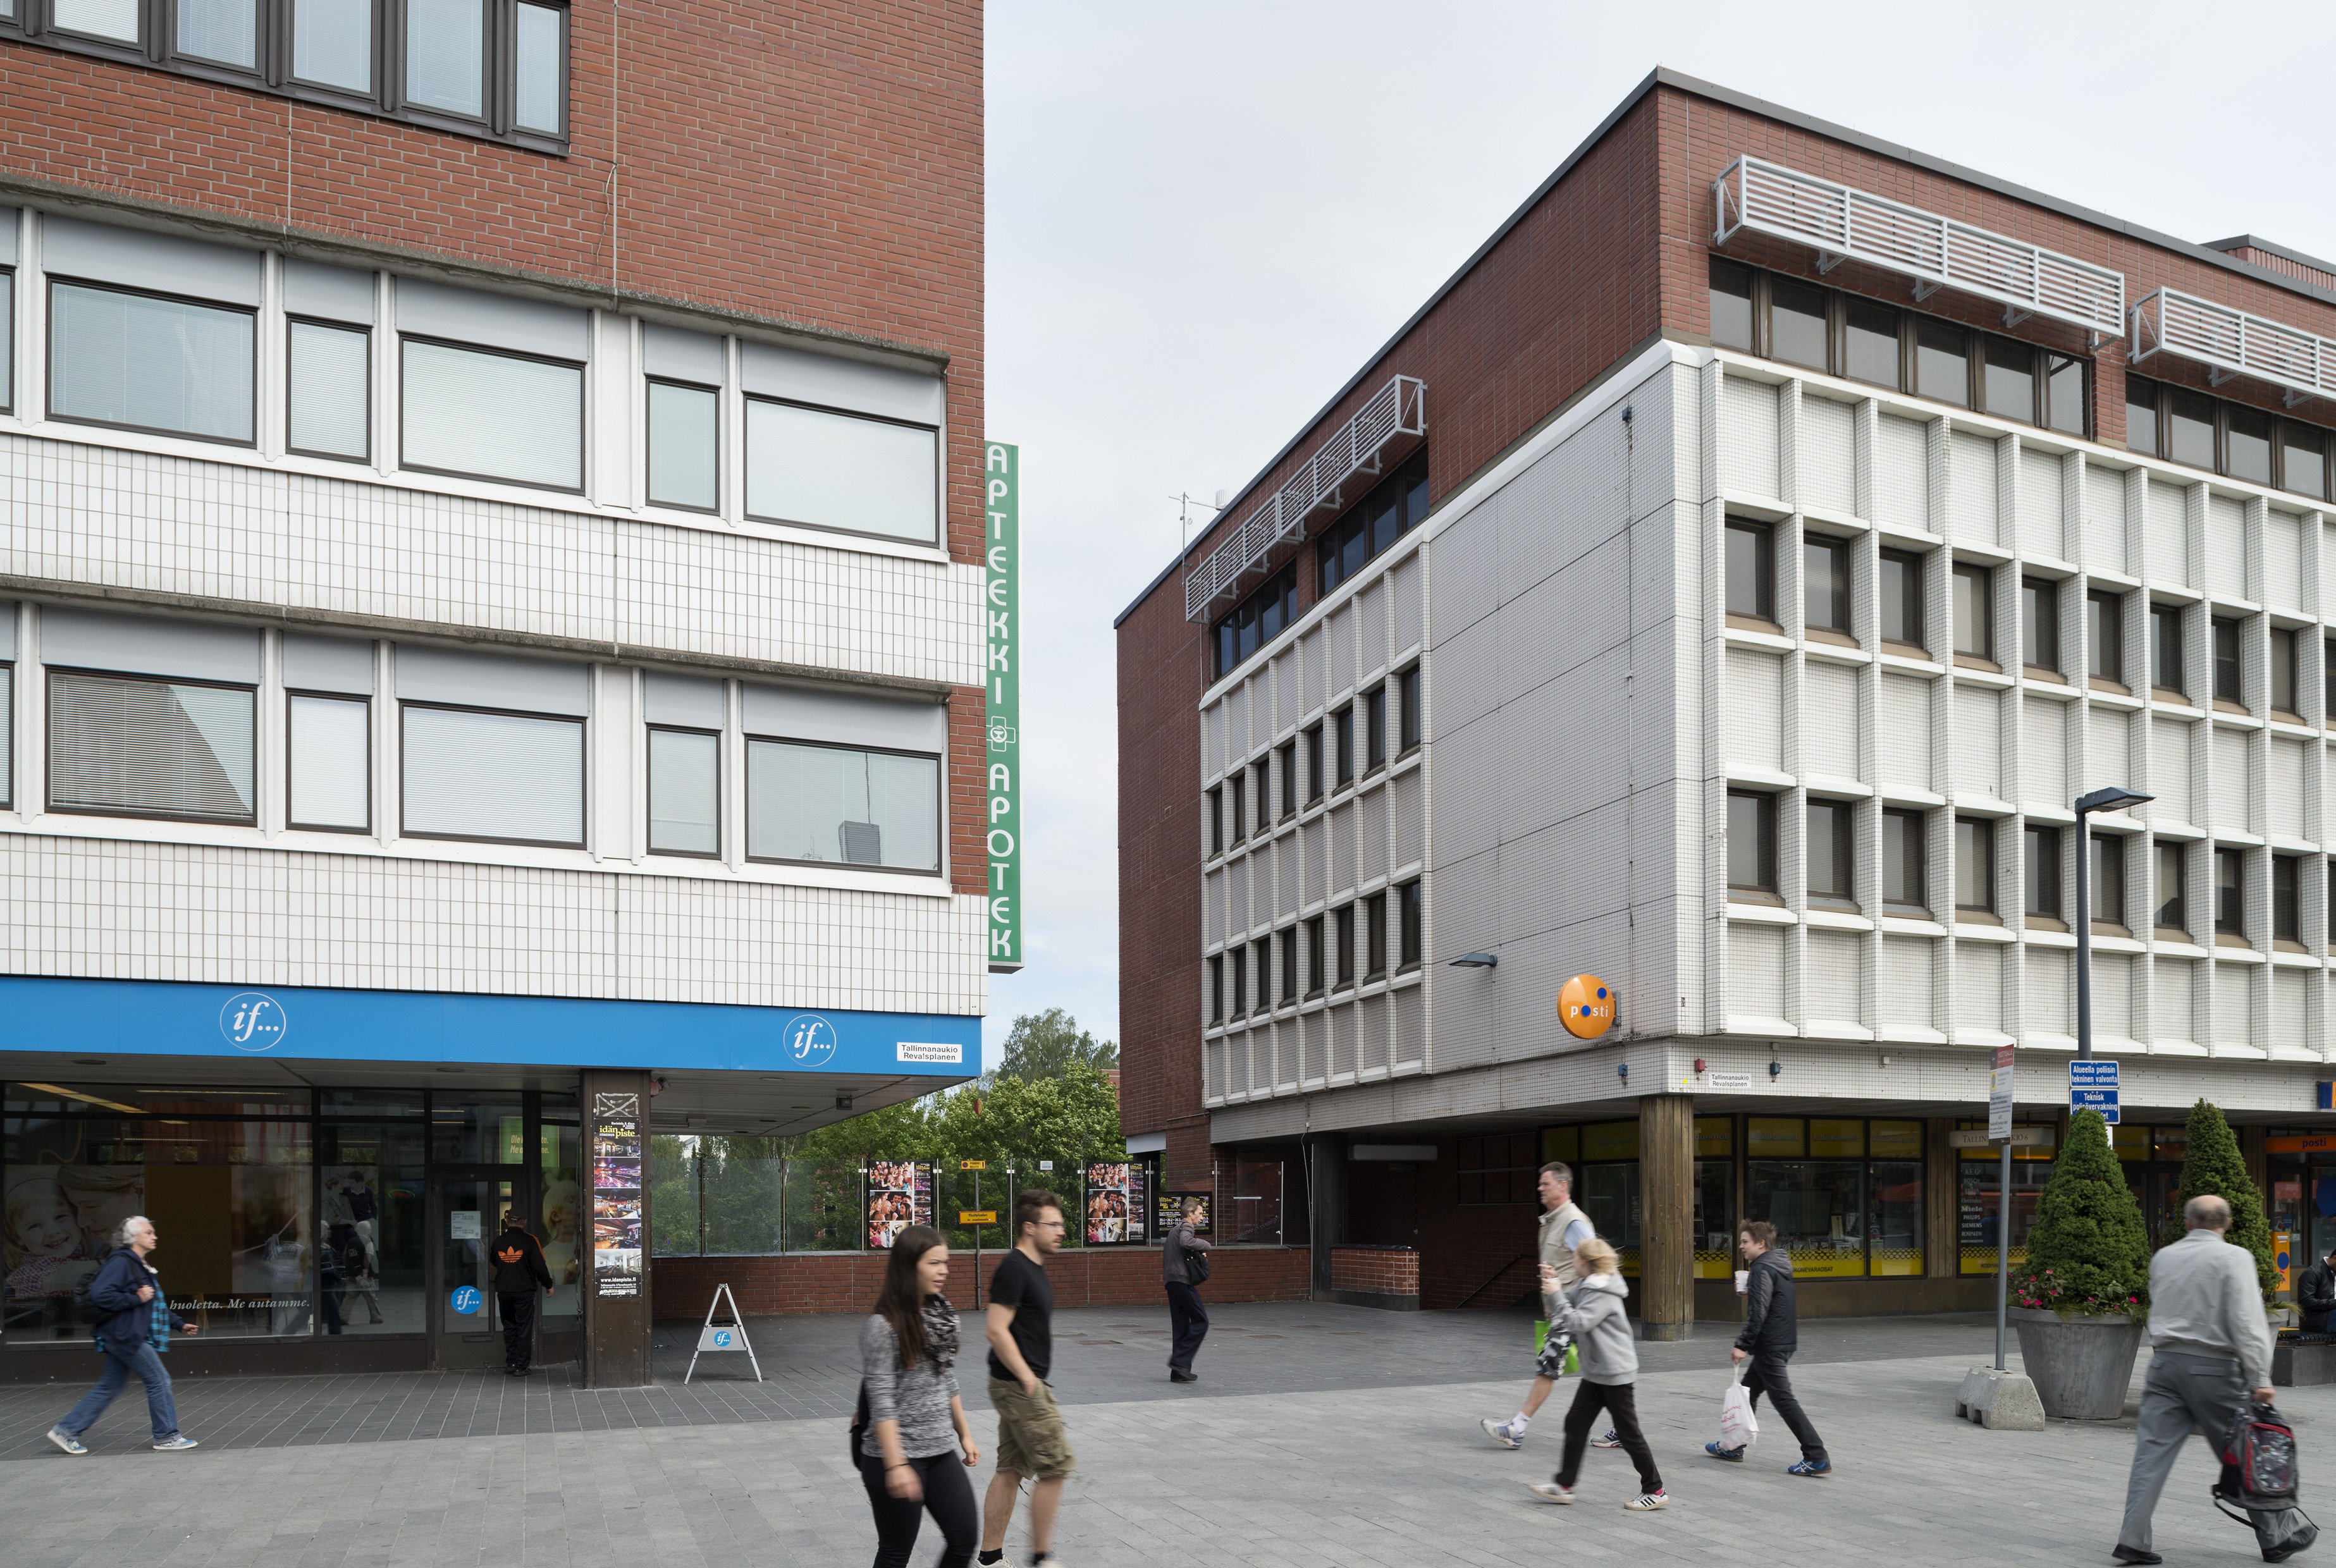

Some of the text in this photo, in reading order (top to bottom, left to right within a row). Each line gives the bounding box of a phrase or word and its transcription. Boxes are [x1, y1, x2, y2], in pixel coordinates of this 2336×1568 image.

[987, 444, 1009, 704] APTEEKKI
[987, 763, 1014, 957] APOTEK
[901, 1044, 958, 1053] Tallinnanaukio
[904, 1052, 956, 1060] Revalsplanen
[2073, 1065, 2115, 1075] Alueella poliisin
[2072, 1075, 2094, 1083] tekninen
[2084, 1093, 2105, 1101] Teknisk
[1694, 1132, 1728, 1141] one.net
[2302, 1137, 2327, 1149] posti
[169, 1298, 310, 1310] huoletta. Me autamme.
